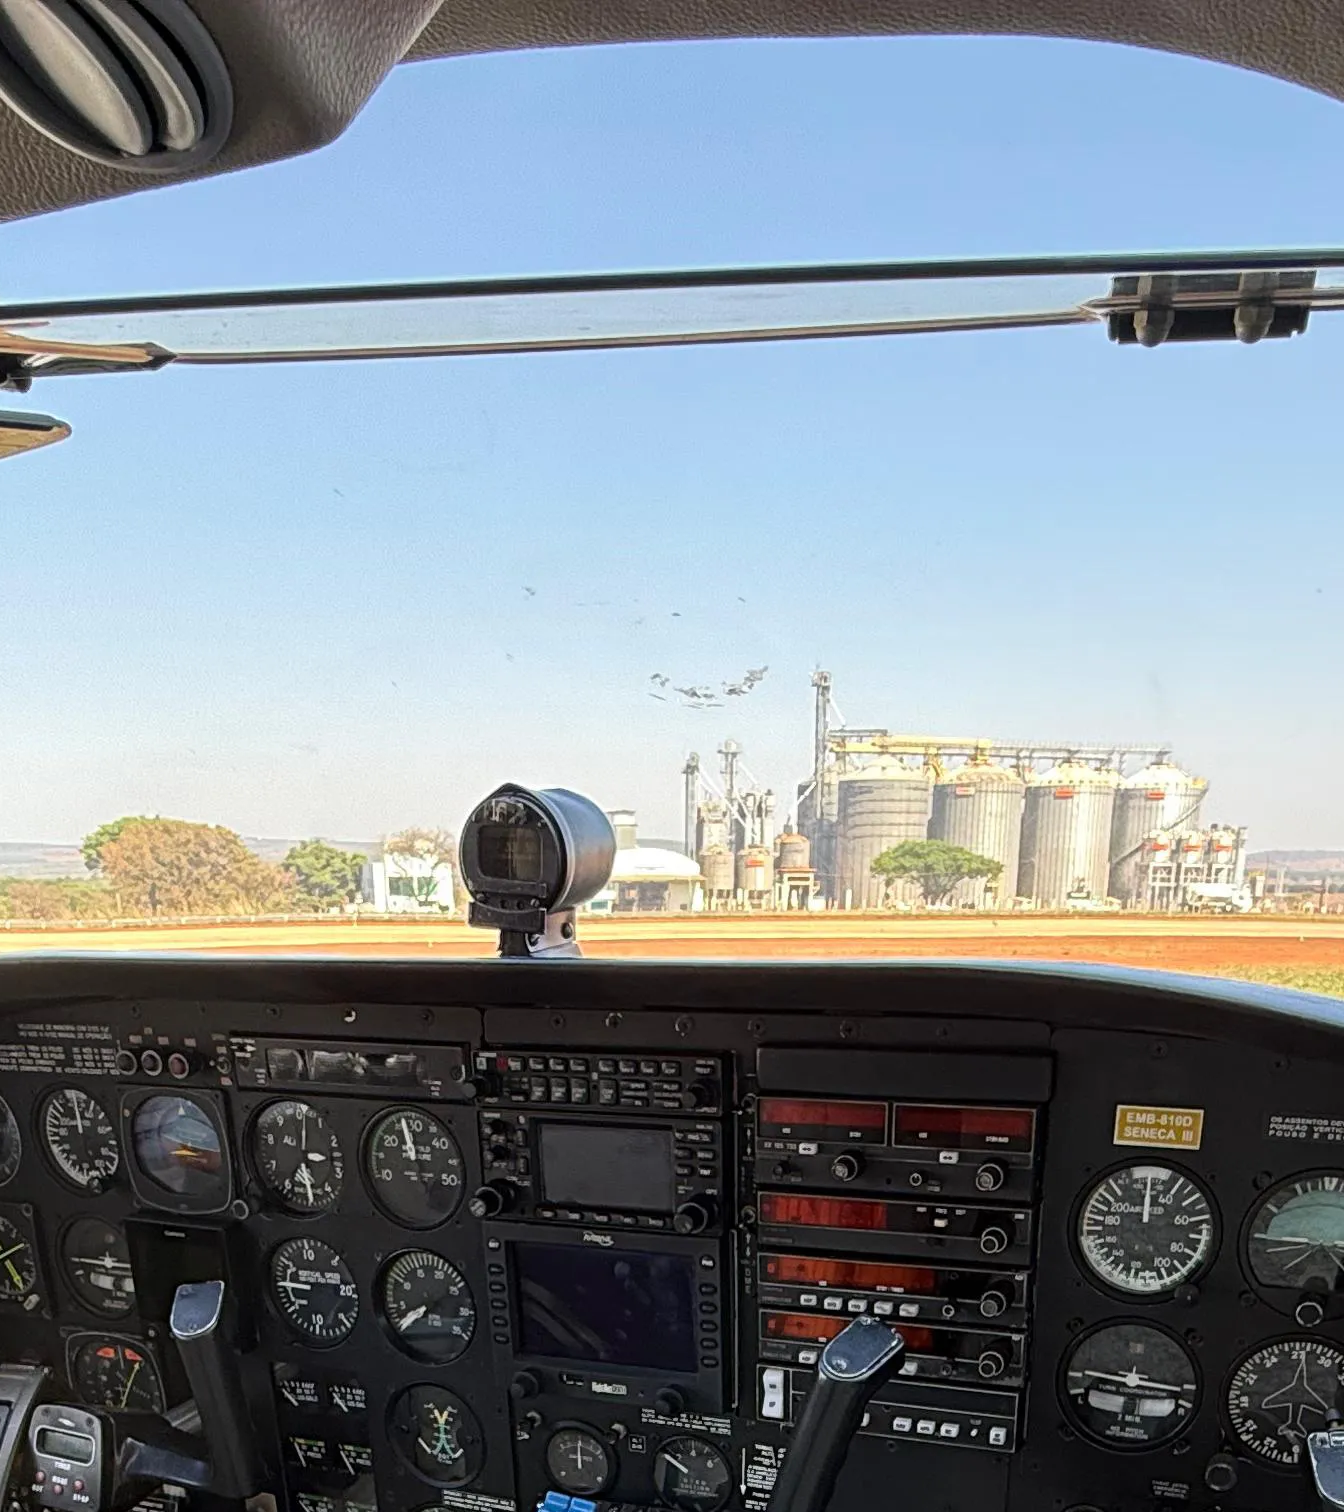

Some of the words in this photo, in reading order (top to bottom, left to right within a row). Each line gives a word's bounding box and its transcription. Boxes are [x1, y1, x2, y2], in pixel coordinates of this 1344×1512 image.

[1126, 1112, 1193, 1127] EMB-810D
[1284, 1117, 1329, 1126] ASSENTOS
[408, 1119, 423, 1133] 30
[1124, 1126, 1176, 1141] SENECA
[1182, 1129, 1193, 1142] III
[1268, 1129, 1307, 1138] POUSO
[330, 1135, 339, 1148] 2
[383, 1135, 399, 1148] 20
[432, 1137, 449, 1150] 40
[335, 1167, 344, 1179] 3
[382, 1168, 393, 1181] 10
[284, 1178, 292, 1190] 6
[441, 1173, 458, 1186] 50
[1158, 1193, 1174, 1205] 40
[1110, 1202, 1130, 1214] 200
[1174, 1215, 1190, 1226] 60
[1170, 1242, 1185, 1253] 80
[303, 1248, 316, 1262] 10
[1153, 1257, 1172, 1268] 100
[339, 1284, 353, 1297] 20
[312, 1313, 324, 1326] 10
[1290, 1350, 1306, 1360] 27
[1316, 1356, 1333, 1368] 30
